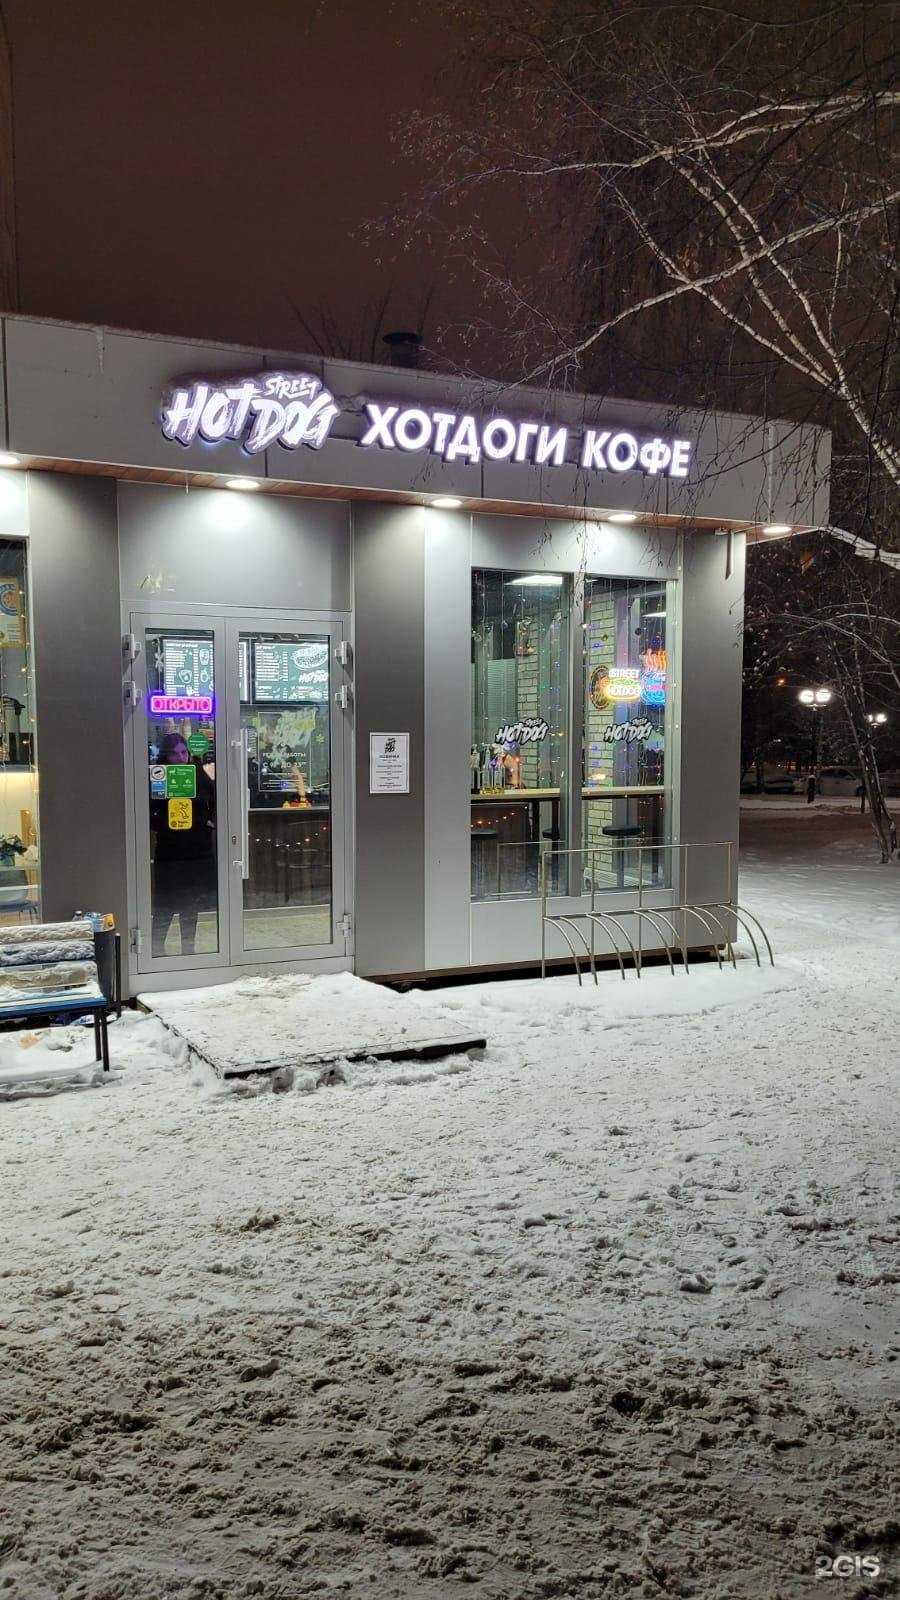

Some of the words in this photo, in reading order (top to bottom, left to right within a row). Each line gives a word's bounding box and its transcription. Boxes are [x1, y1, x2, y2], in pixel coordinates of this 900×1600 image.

[265, 376, 319, 400] STREET
[361, 403, 567, 465] ХОТДОГИ
[583, 430, 692, 477] КОФЕ
[153, 699, 210, 712] ОТКРЫТО
